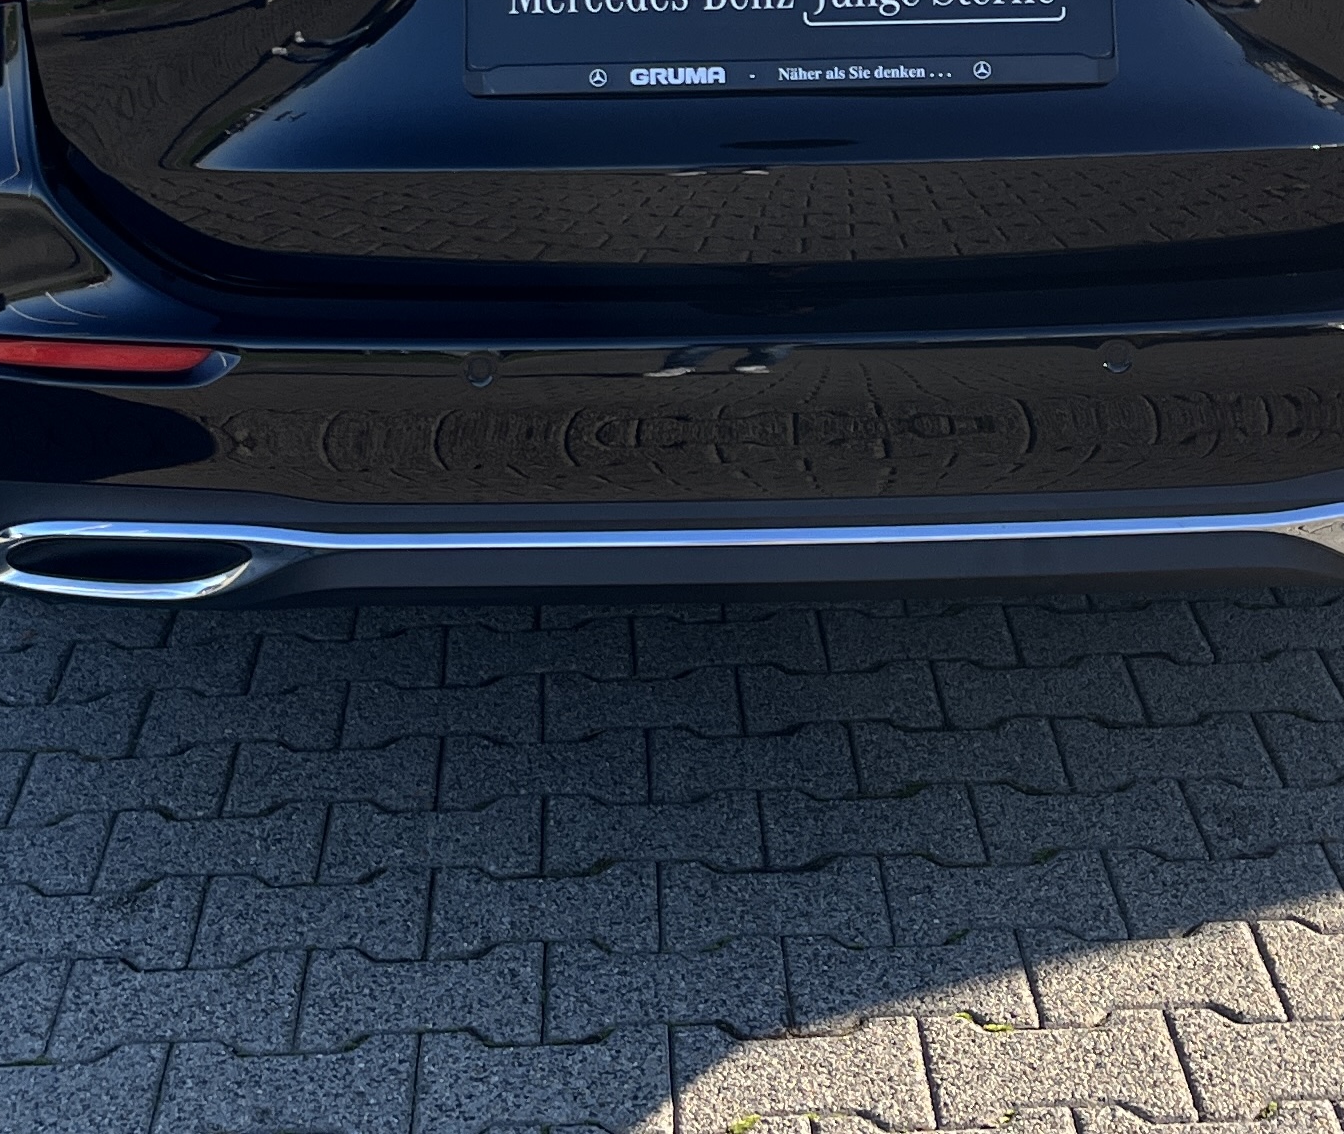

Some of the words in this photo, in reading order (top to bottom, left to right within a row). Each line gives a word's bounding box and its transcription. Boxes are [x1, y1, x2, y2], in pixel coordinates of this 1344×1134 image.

[629, 67, 726, 86] GRUMA
[777, 67, 823, 81] Näher
[825, 66, 846, 81] als
[848, 65, 871, 80] Sie
[874, 65, 926, 79] denken
